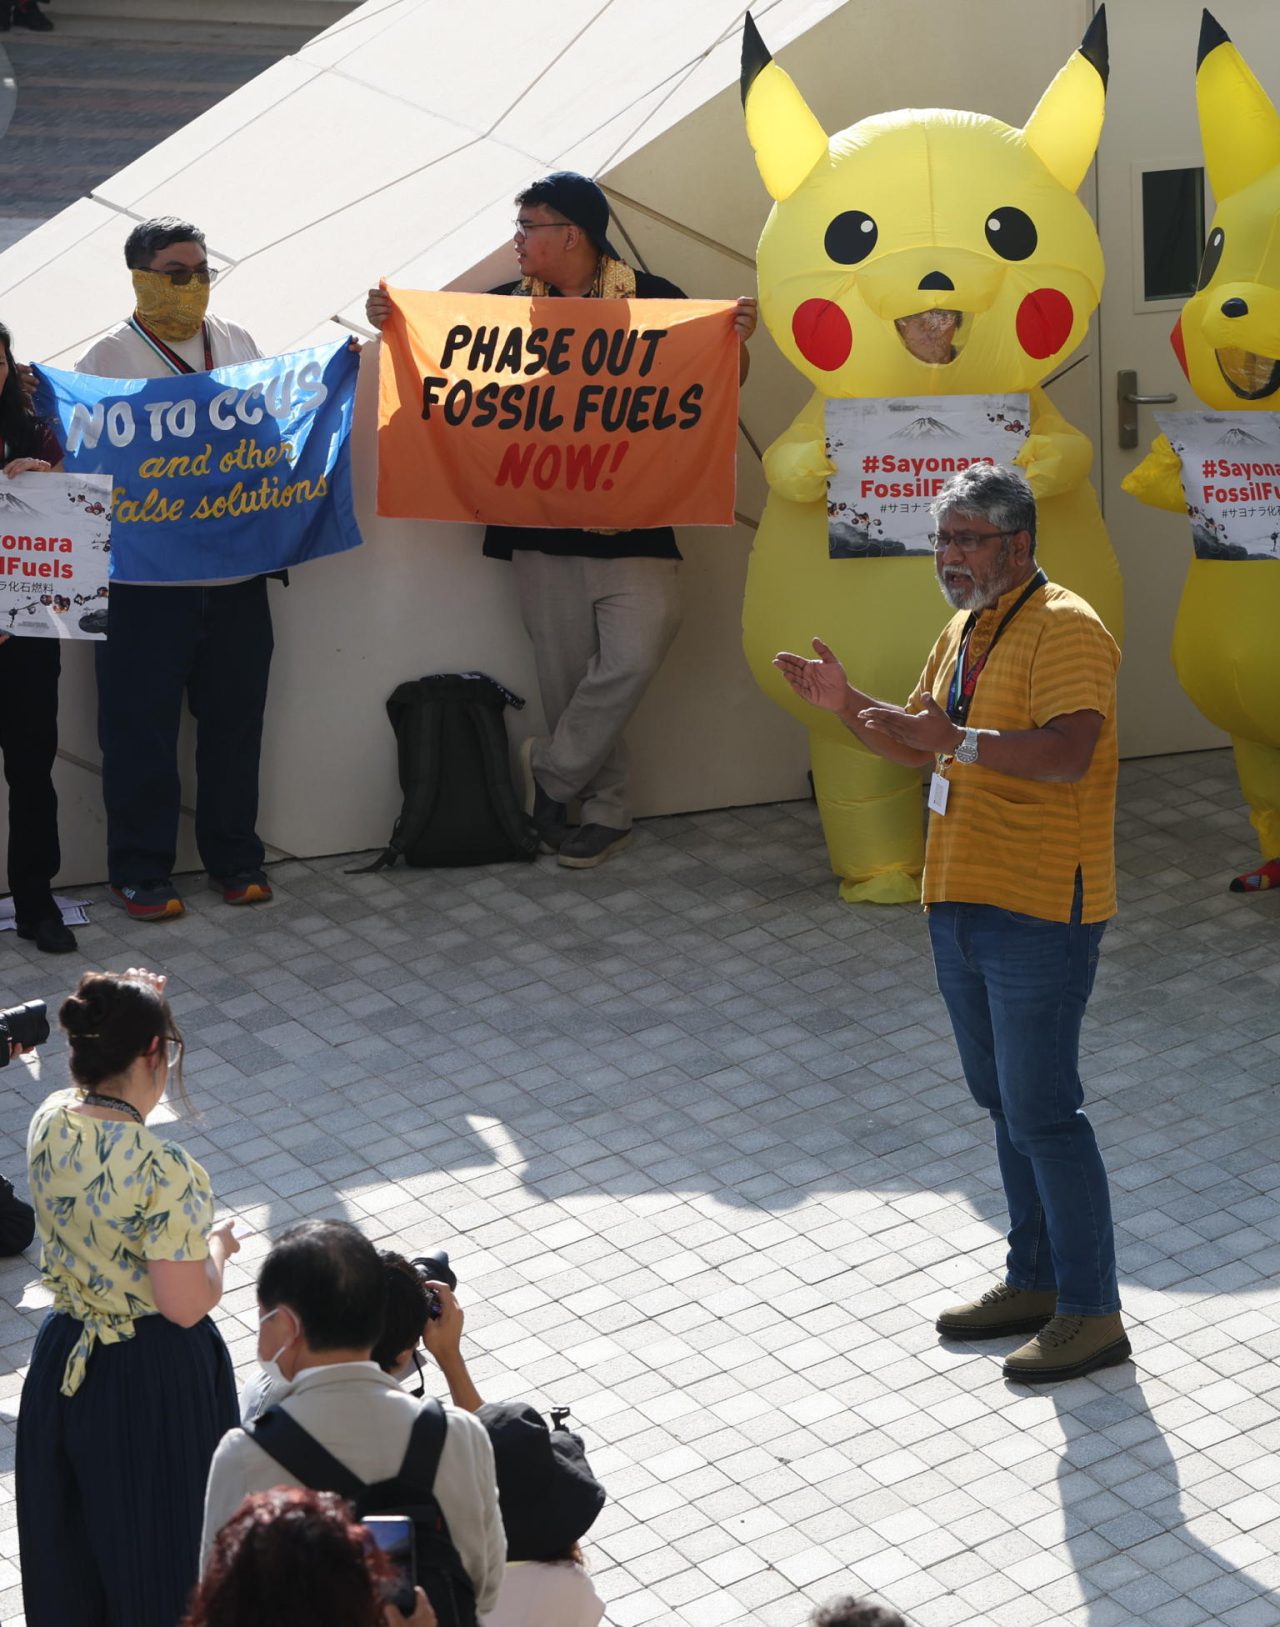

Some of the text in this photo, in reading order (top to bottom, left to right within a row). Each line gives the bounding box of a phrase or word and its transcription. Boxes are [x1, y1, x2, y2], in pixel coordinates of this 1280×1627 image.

[440, 324, 667, 378] PHASE OUT
[66, 361, 329, 452] NO TO CCUS
[421, 376, 704, 433] FOSSIL FUELS
[138, 438, 297, 479] and other
[495, 440, 630, 492] NOW!
[190, 473, 329, 519] solutions
